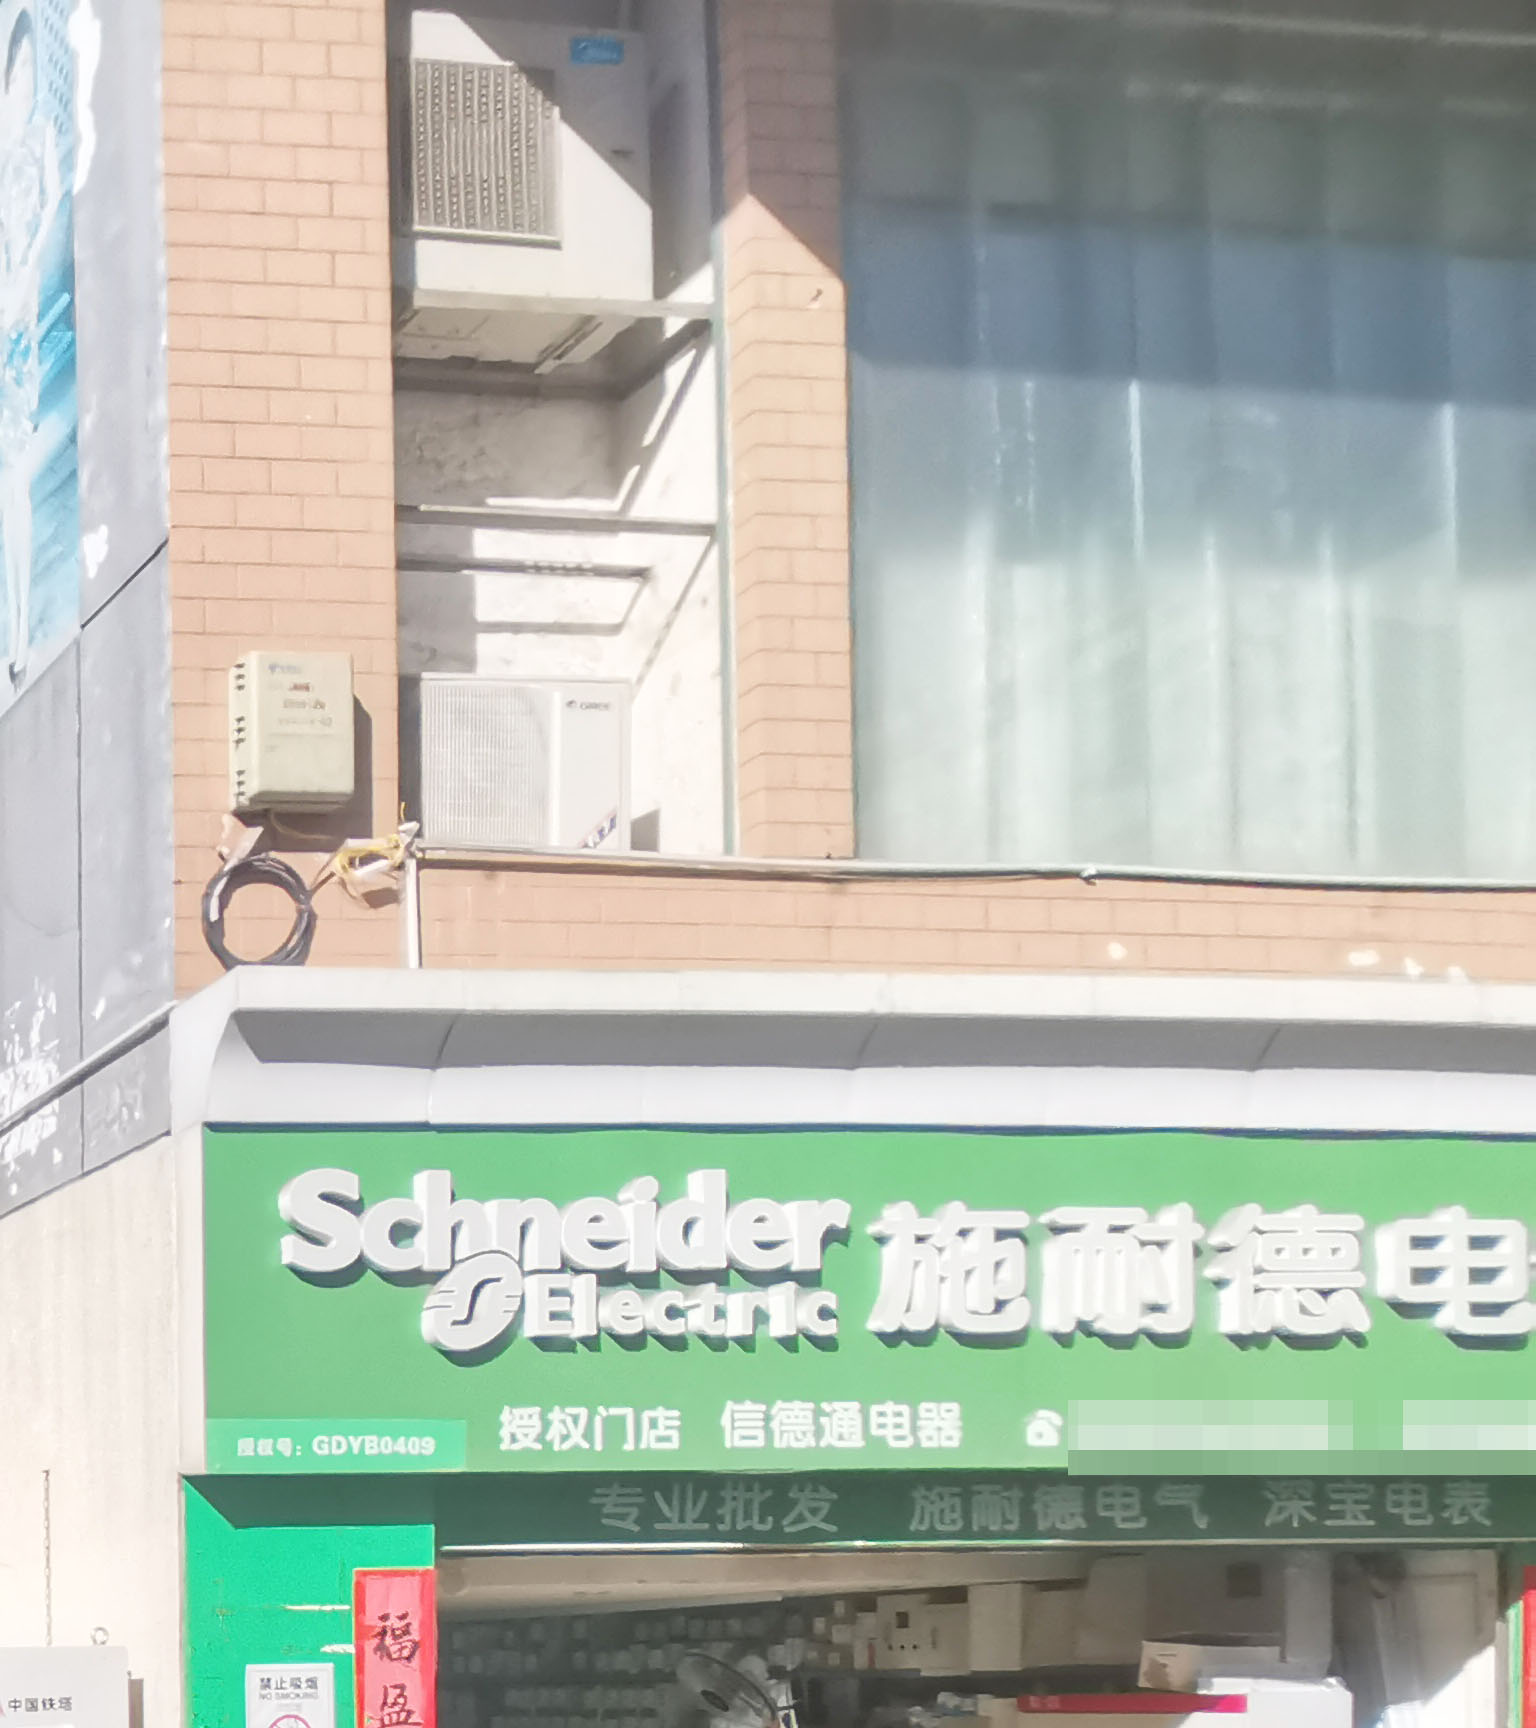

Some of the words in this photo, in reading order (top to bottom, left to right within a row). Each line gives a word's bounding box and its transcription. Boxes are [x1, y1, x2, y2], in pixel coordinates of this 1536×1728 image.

[278, 1167, 852, 1273] Schneider
[867, 1201, 1536, 1336] 施耐德电
[522, 1272, 839, 1339] Electric
[498, 1404, 682, 1452] 授权门店
[720, 1400, 963, 1450] 信德通电器
[590, 1481, 840, 1534] 专业批发
[908, 1482, 1210, 1535] 施耐德电气
[1263, 1479, 1493, 1531] 深宝电表
[8, 1696, 73, 1712] 中国铁塔
